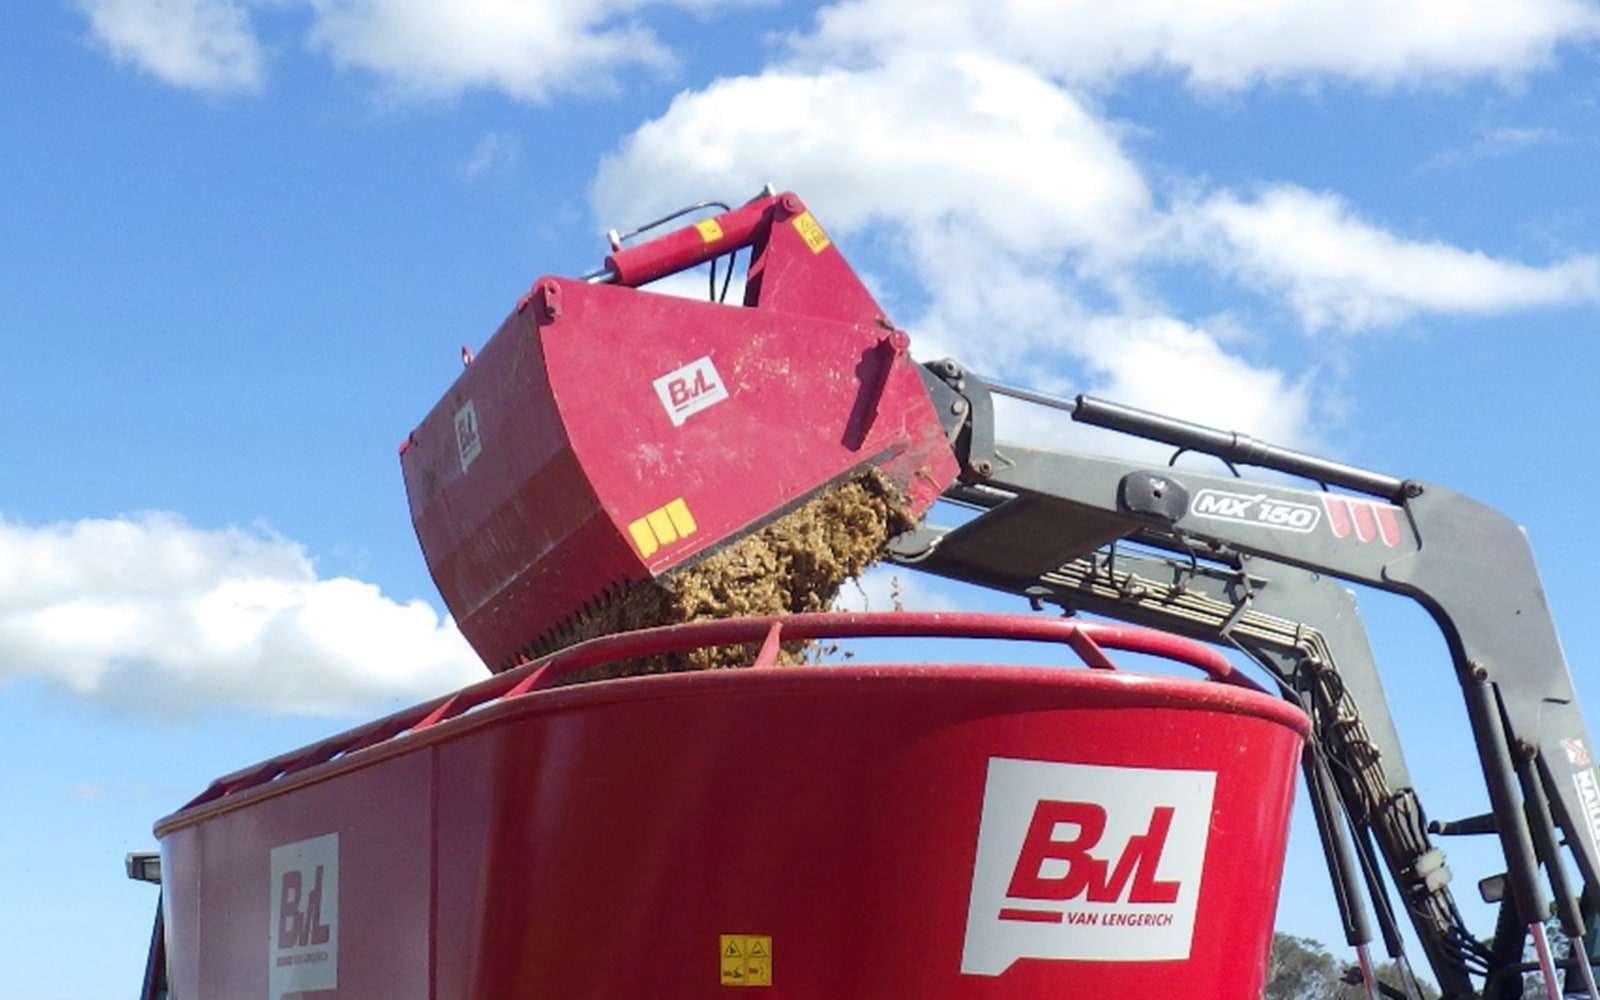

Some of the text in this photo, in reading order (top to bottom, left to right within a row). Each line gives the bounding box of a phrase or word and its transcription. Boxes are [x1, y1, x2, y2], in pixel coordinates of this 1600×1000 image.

[1199, 494, 1312, 527] MX 150
[1067, 912, 1174, 927] VAN LENGERICH
